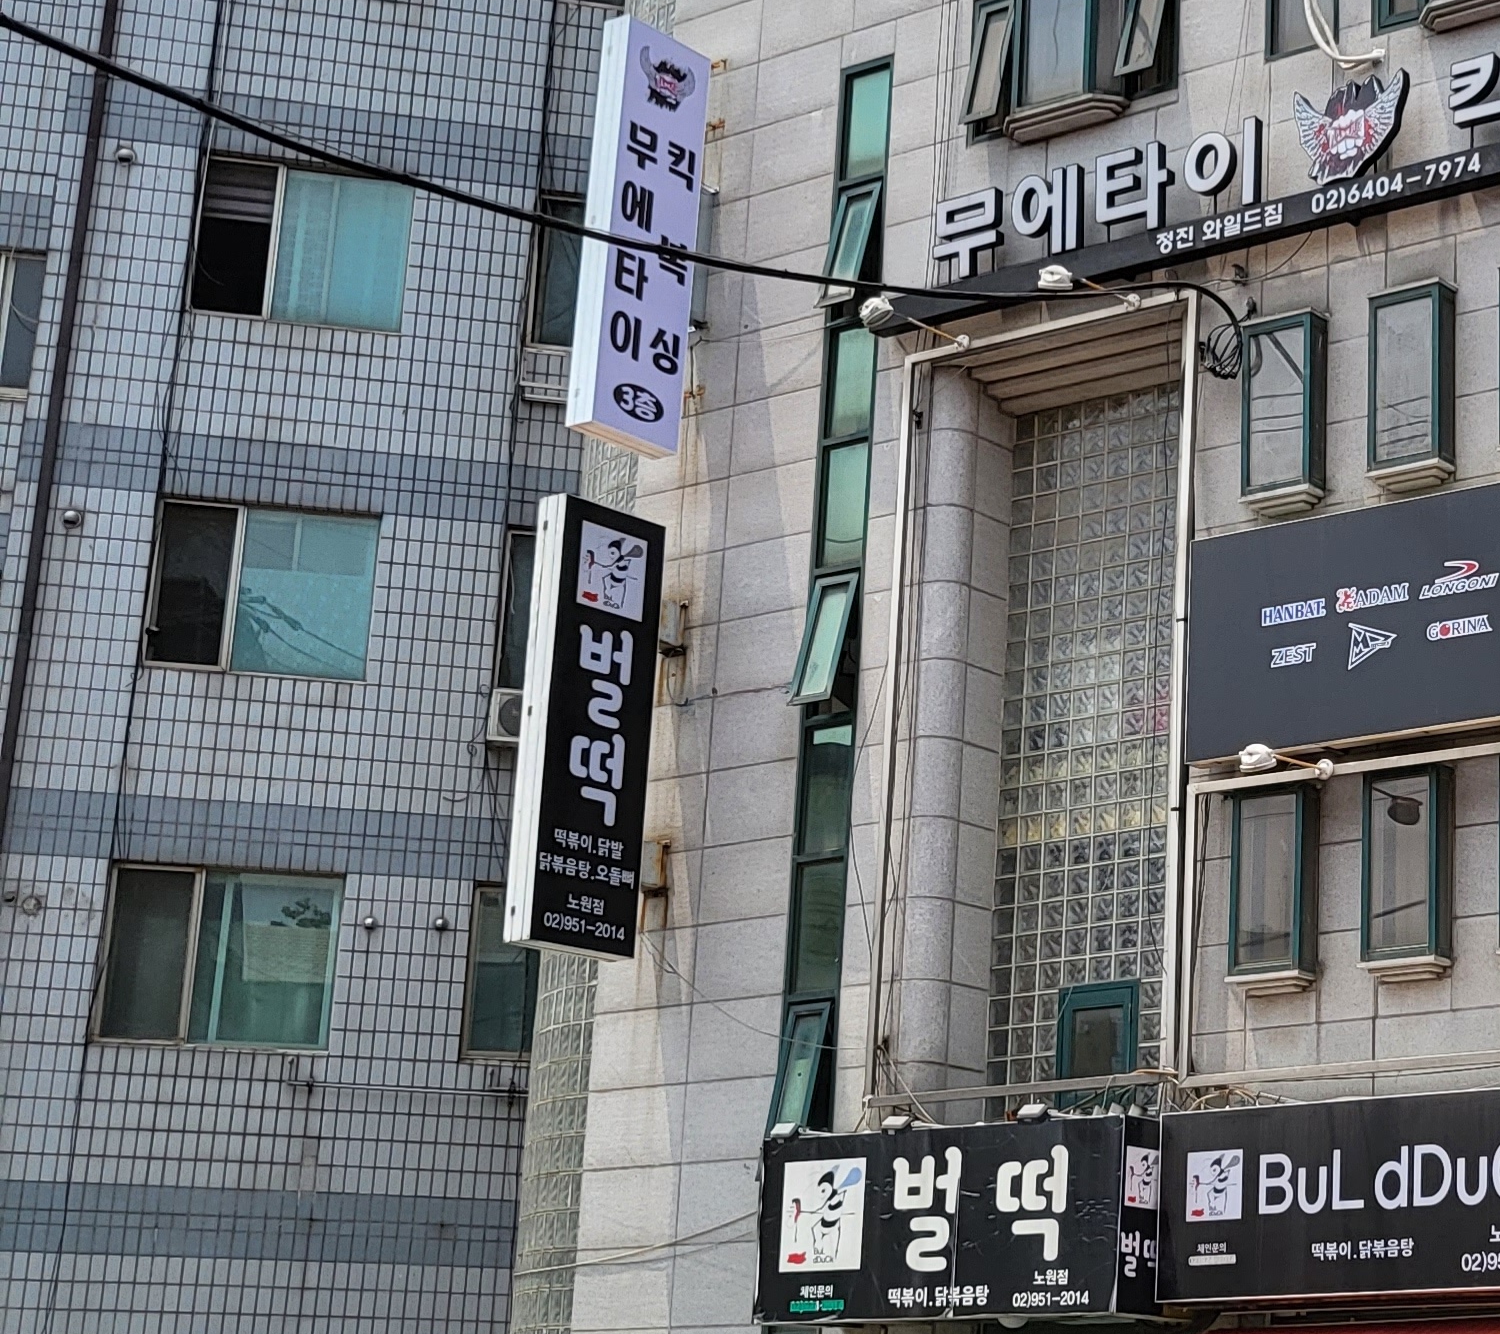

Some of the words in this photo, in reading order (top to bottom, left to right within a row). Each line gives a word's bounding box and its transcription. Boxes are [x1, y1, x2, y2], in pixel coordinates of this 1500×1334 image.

[932, 115, 1264, 278] 무에타이
[1155, 224, 1195, 255] 정진
[1201, 202, 1285, 241] 와일드짐
[1310, 152, 1483, 215] 02)6404-7974
[610, 120, 658, 361] 무에타이
[650, 141, 696, 376] 킥복싱
[620, 385, 659, 421] 3층
[1354, 583, 1409, 608] ADAM
[1419, 572, 1500, 601] LONGONI
[1261, 598, 1326, 627] HANBAT
[1270, 642, 1317, 668] ZEST
[569, 623, 634, 827] 벌떡
[566, 893, 605, 916] 노원점
[543, 912, 626, 942] 02)951-2014
[893, 1144, 1069, 1272] 벌떡
[1311, 1237, 1415, 1261] 떡볶이.닭볶음탕
[1032, 1268, 1069, 1286] 노원점
[1012, 1289, 1090, 1308] 02)951-2014
